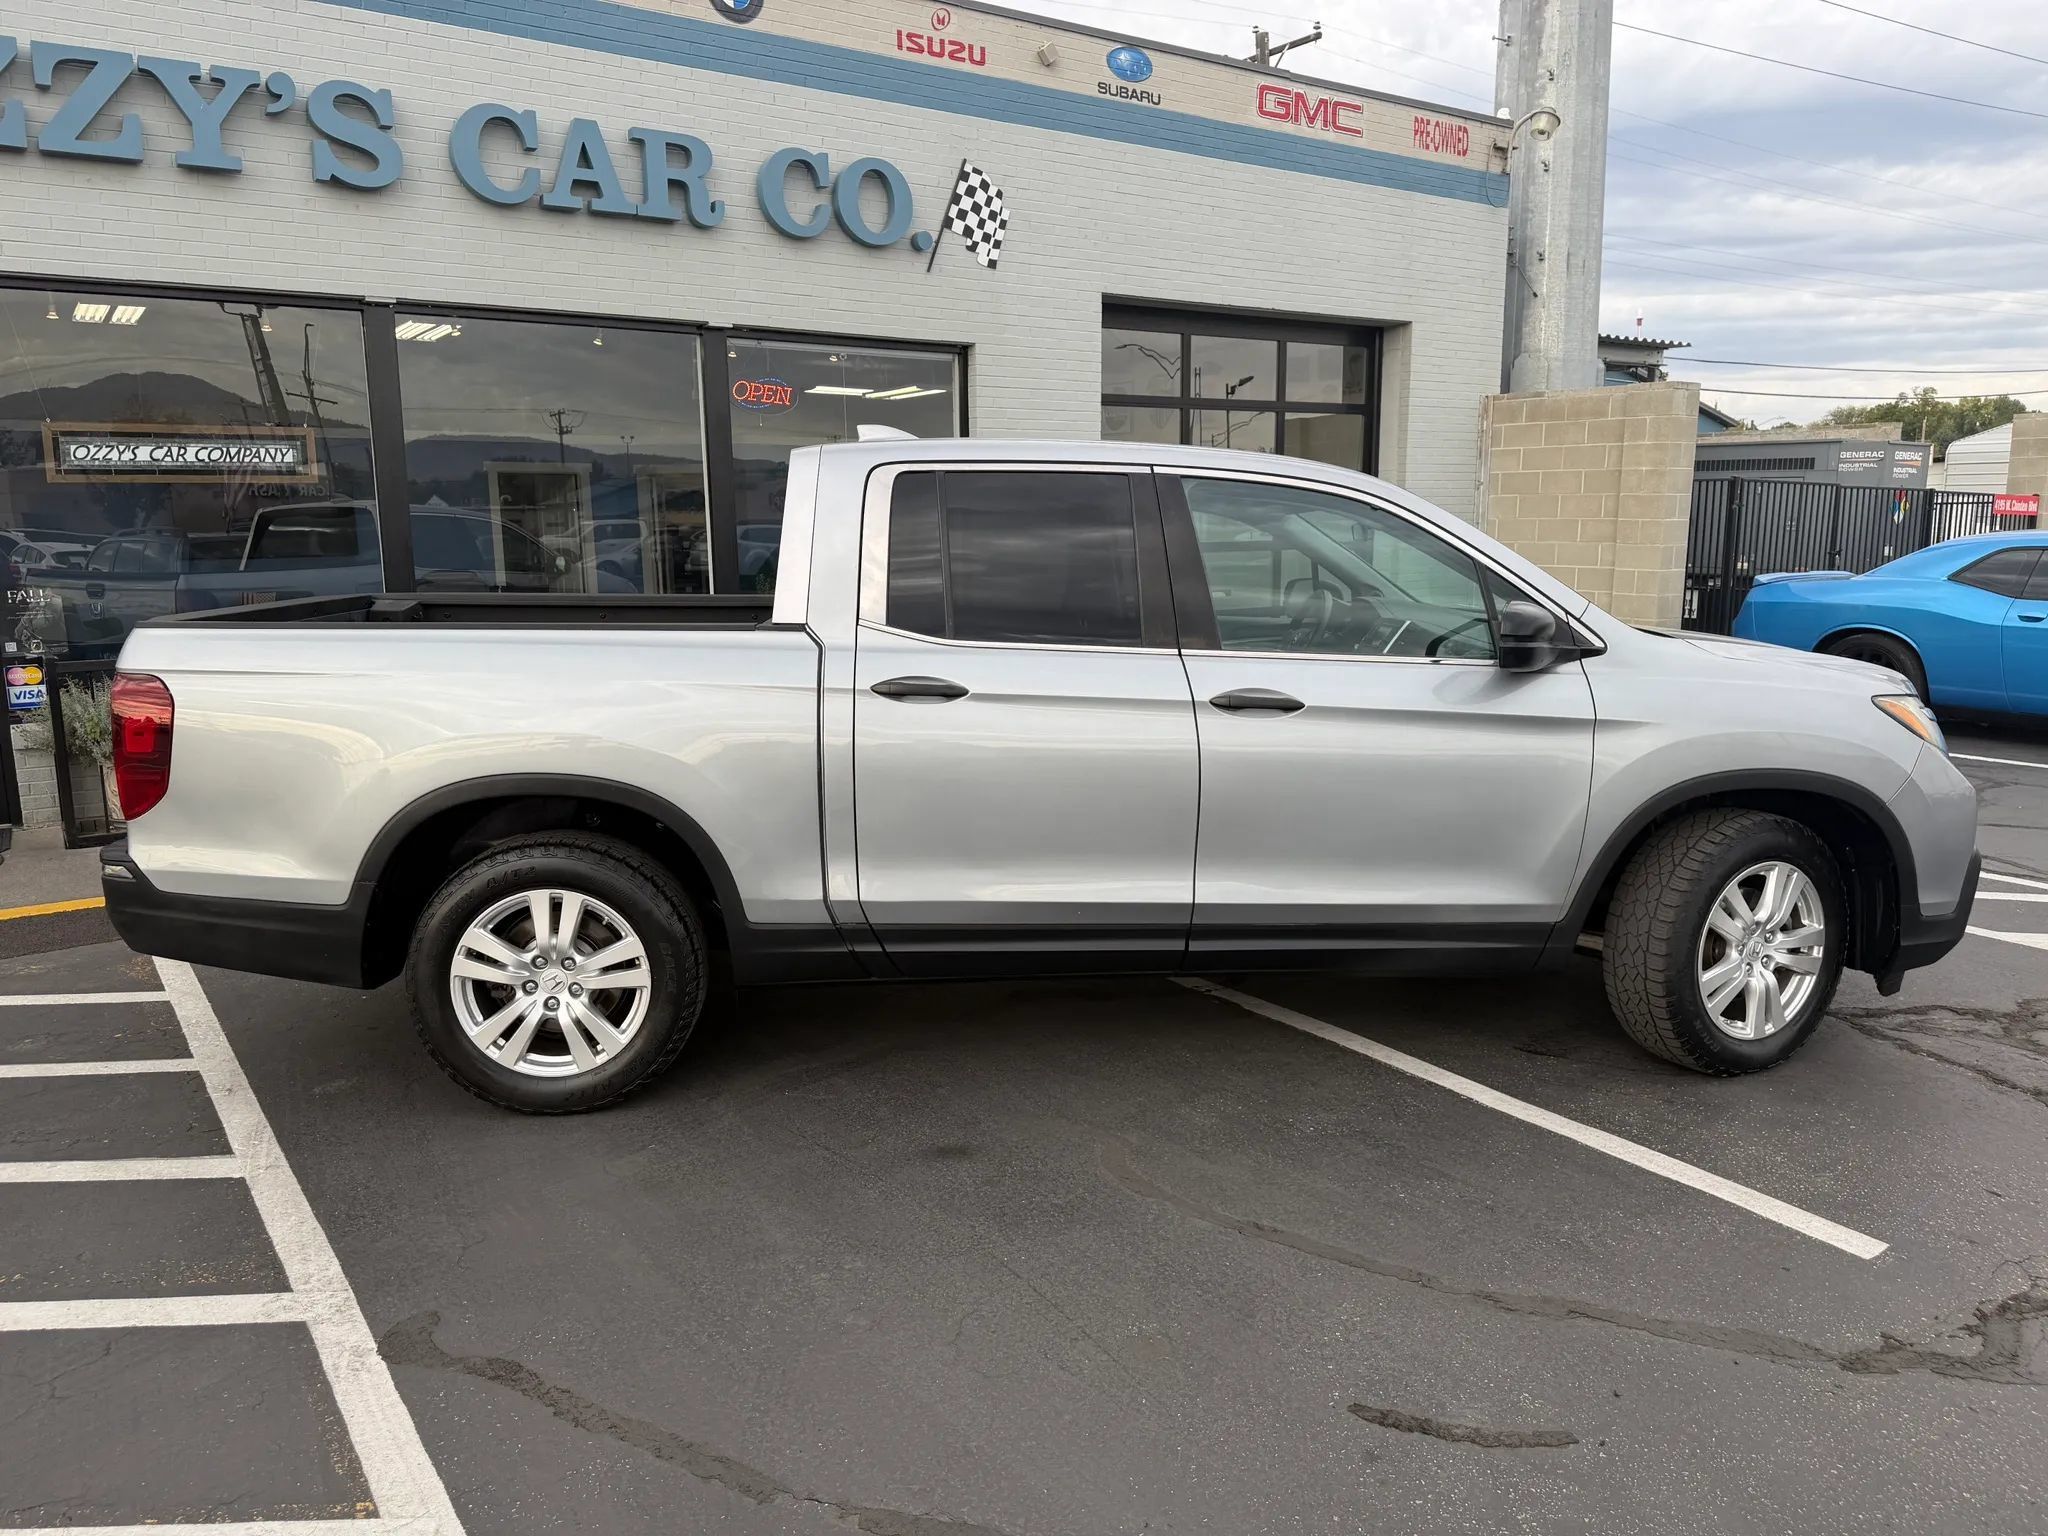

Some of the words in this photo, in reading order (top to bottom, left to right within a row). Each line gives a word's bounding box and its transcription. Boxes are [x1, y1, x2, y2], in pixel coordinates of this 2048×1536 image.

[896, 29, 986, 67] ISUZU
[1096, 80, 1162, 107] SUBARU
[1255, 81, 1364, 138] GMC
[0, 34, 403, 191] ZY'S
[449, 102, 726, 230] CAR
[757, 147, 934, 252] CO.
[1412, 114, 1470, 158] PRE-OWNED
[732, 379, 793, 405] OPEN
[72, 444, 140, 461] OZZY'S
[149, 445, 188, 462] CAR
[194, 446, 290, 464] COMPANY
[1839, 450, 1885, 459] GENERAC
[1894, 450, 1923, 460] GENERAC
[7, 589, 51, 603] FALL
[14, 689, 45, 700] VISA
